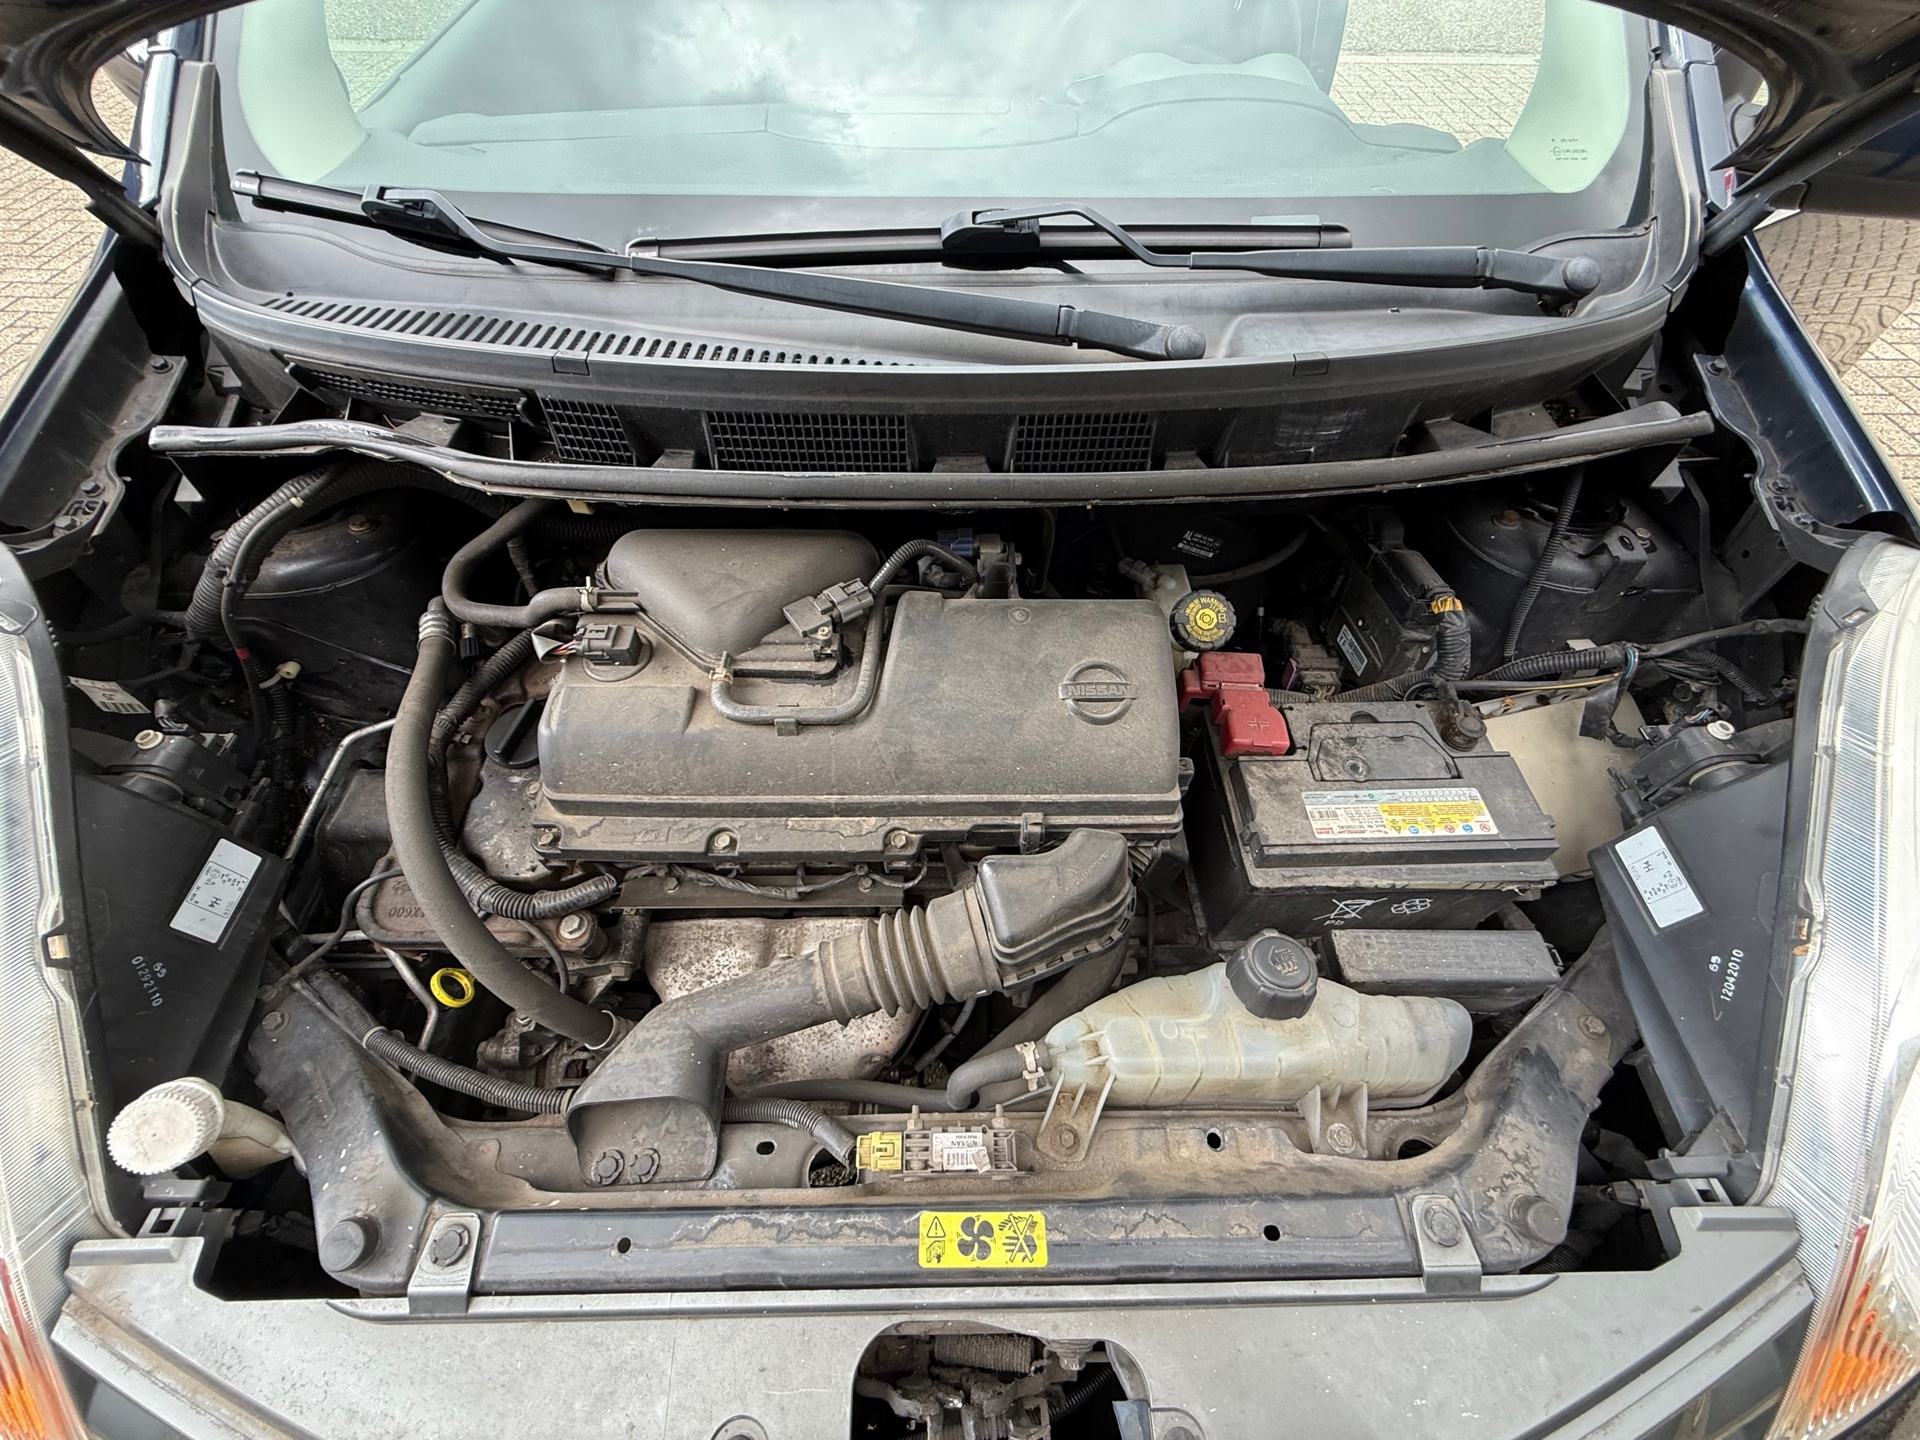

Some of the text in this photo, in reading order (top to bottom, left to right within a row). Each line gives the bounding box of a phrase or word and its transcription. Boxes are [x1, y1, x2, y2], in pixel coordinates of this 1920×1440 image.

[1200, 597, 1227, 613] WARNING
[1067, 684, 1131, 696] NISSAN
[1720, 949, 1744, 1001] 12042010
